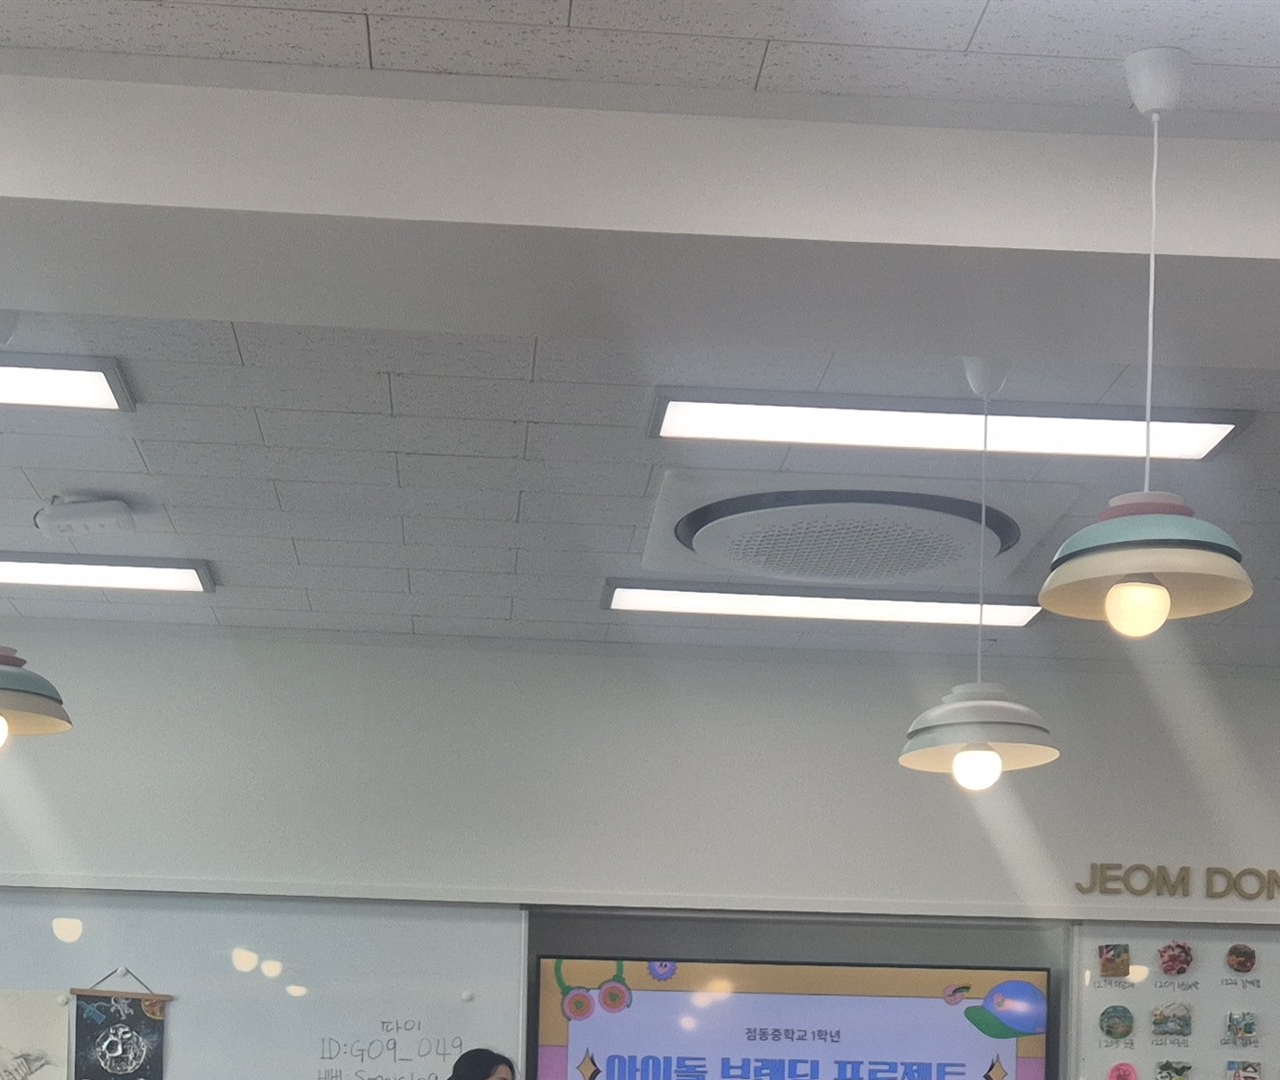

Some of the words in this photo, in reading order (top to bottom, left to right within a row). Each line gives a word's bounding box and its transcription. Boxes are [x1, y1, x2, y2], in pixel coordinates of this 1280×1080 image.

[1074, 862, 1191, 898] JEOM
[745, 1027, 807, 1042] 점동중학교
[811, 1029, 841, 1043] 1학년
